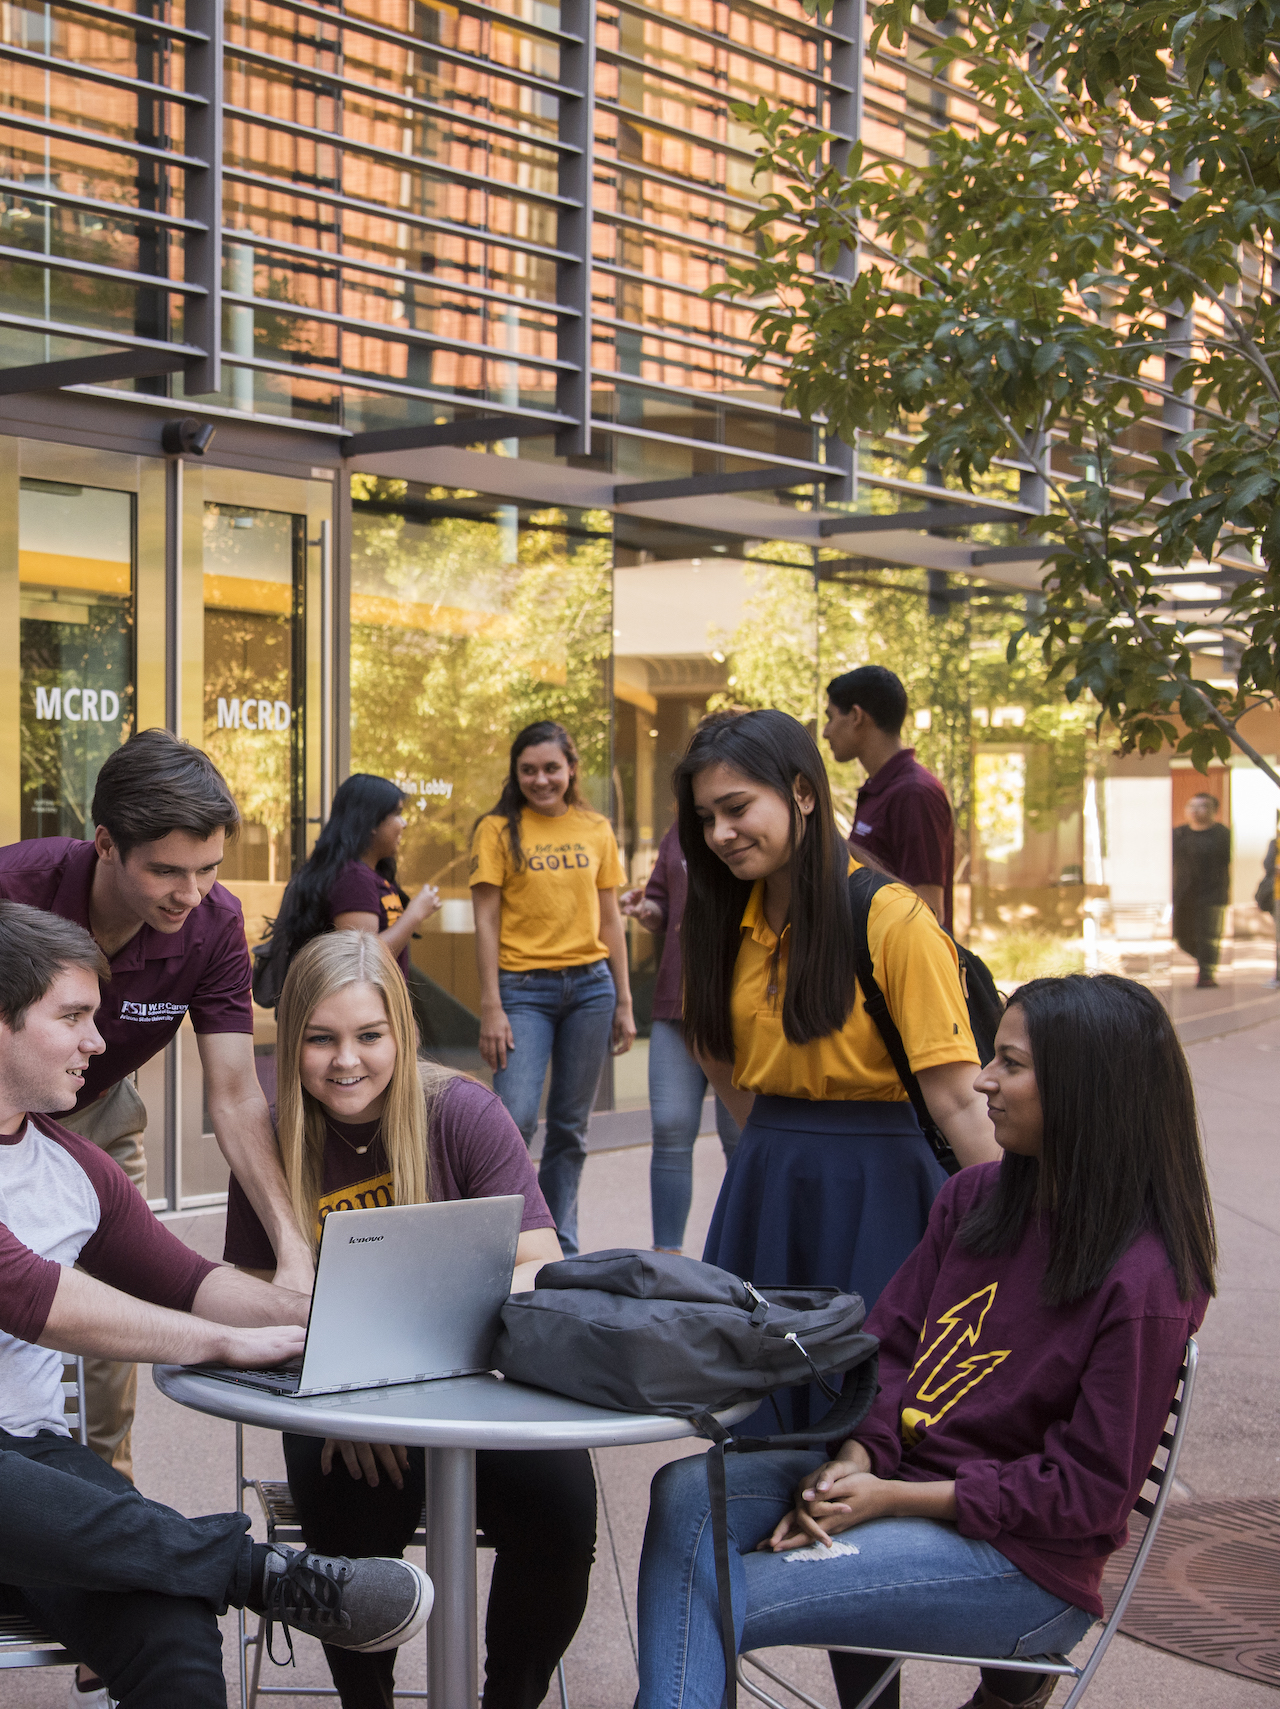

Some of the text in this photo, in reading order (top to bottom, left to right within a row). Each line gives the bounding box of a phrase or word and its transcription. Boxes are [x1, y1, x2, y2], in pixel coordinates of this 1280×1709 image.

[36, 686, 120, 722] MCRD
[217, 697, 291, 731] MCRD
[420, 778, 453, 799] Lobby
[528, 853, 590, 871] GOLD
[121, 1000, 147, 1016] ASU
[165, 1002, 189, 1011] Carey
[349, 1235, 384, 1245] lenovo
